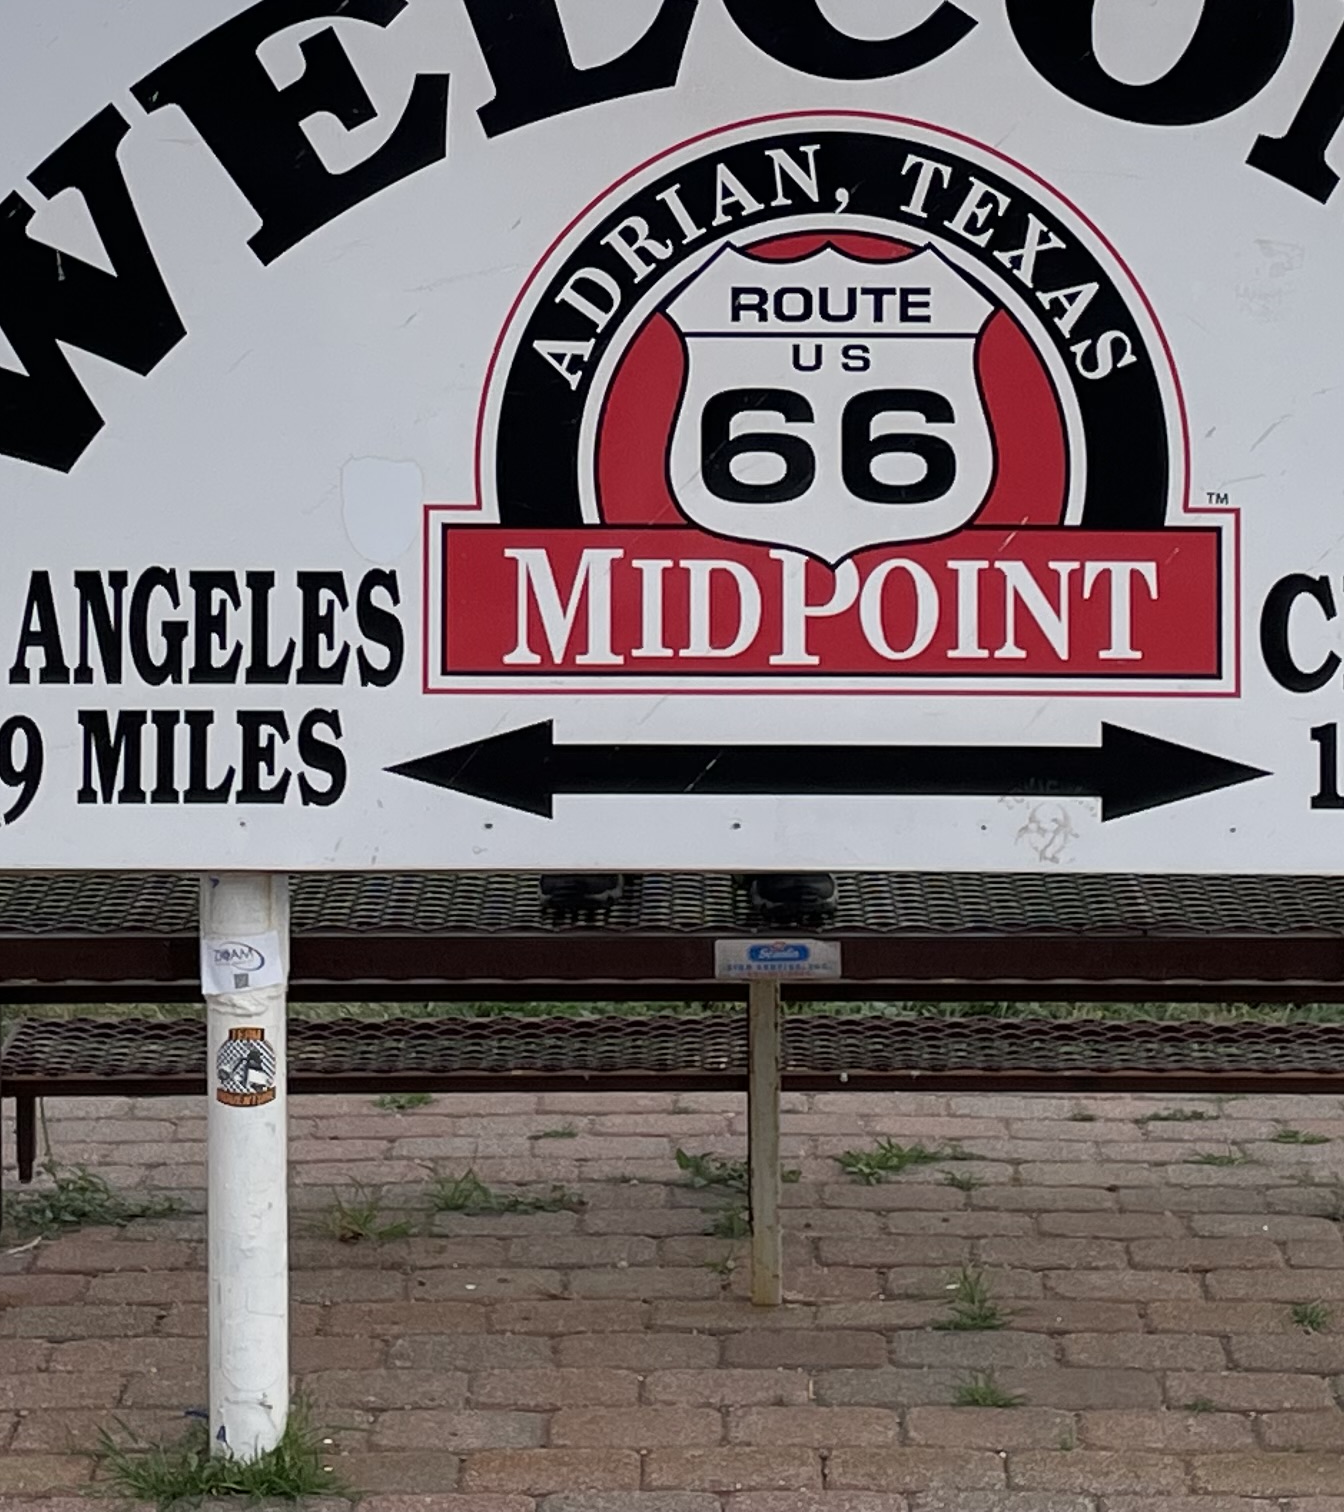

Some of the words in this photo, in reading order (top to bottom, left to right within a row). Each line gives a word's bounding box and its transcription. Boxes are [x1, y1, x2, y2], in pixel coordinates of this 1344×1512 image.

[532, 144, 852, 391] ADRIAN,
[900, 154, 1138, 382] TEXAS
[731, 286, 932, 323] ROUTE
[700, 387, 956, 505] 66
[9, 566, 404, 688] ANGELES
[77, 708, 347, 807] MILES
